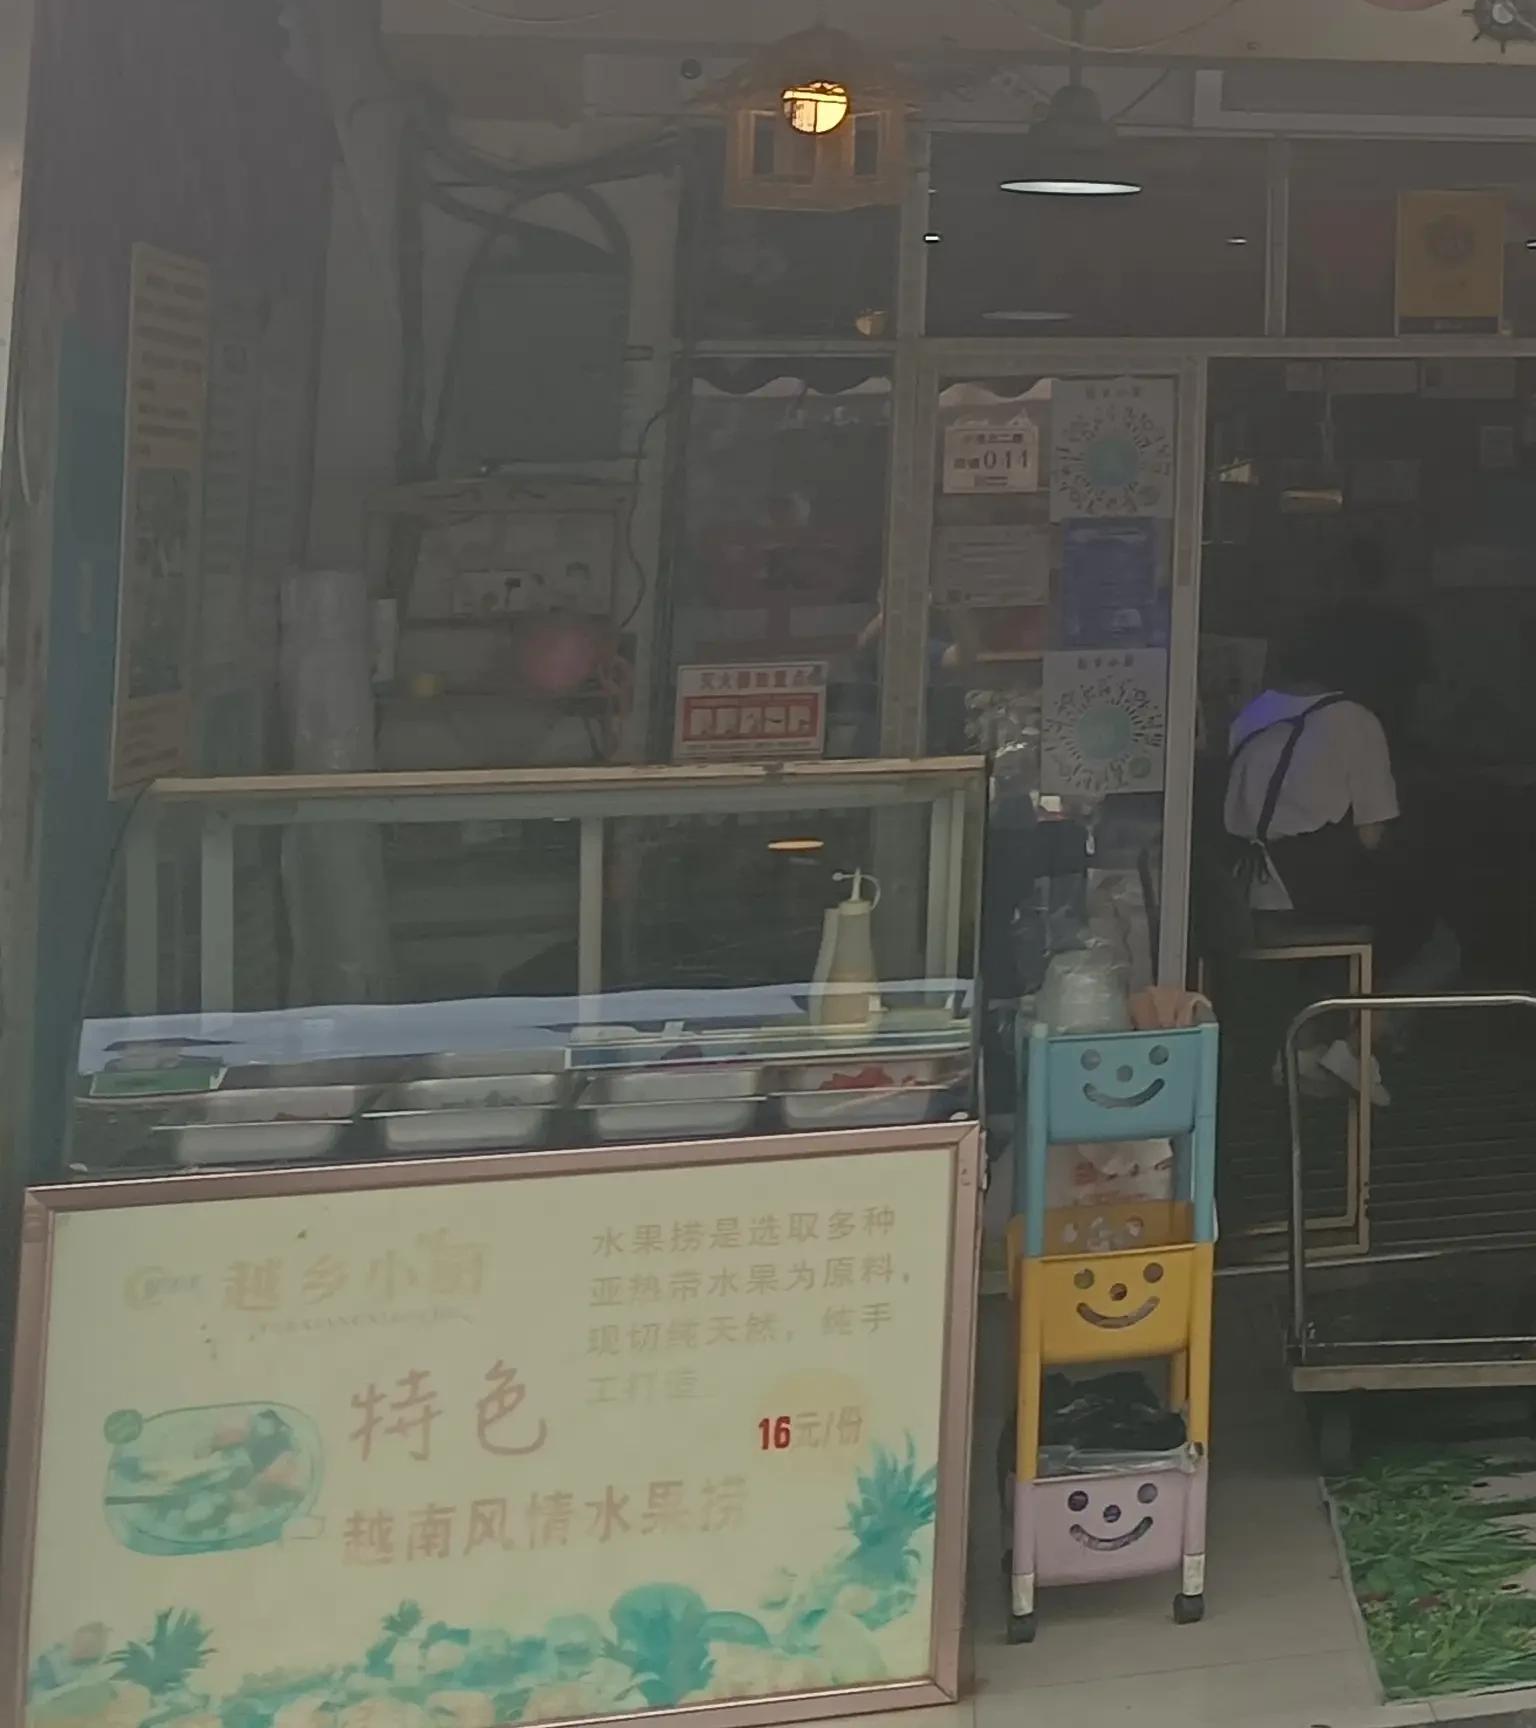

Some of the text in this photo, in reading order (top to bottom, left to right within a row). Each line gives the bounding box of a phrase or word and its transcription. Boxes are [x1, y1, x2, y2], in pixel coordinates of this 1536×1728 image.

[592, 1204, 896, 1258] 水果捞是选取多种
[349, 1358, 549, 1462] 特色
[342, 1475, 749, 1566] 越南风情水果捞
